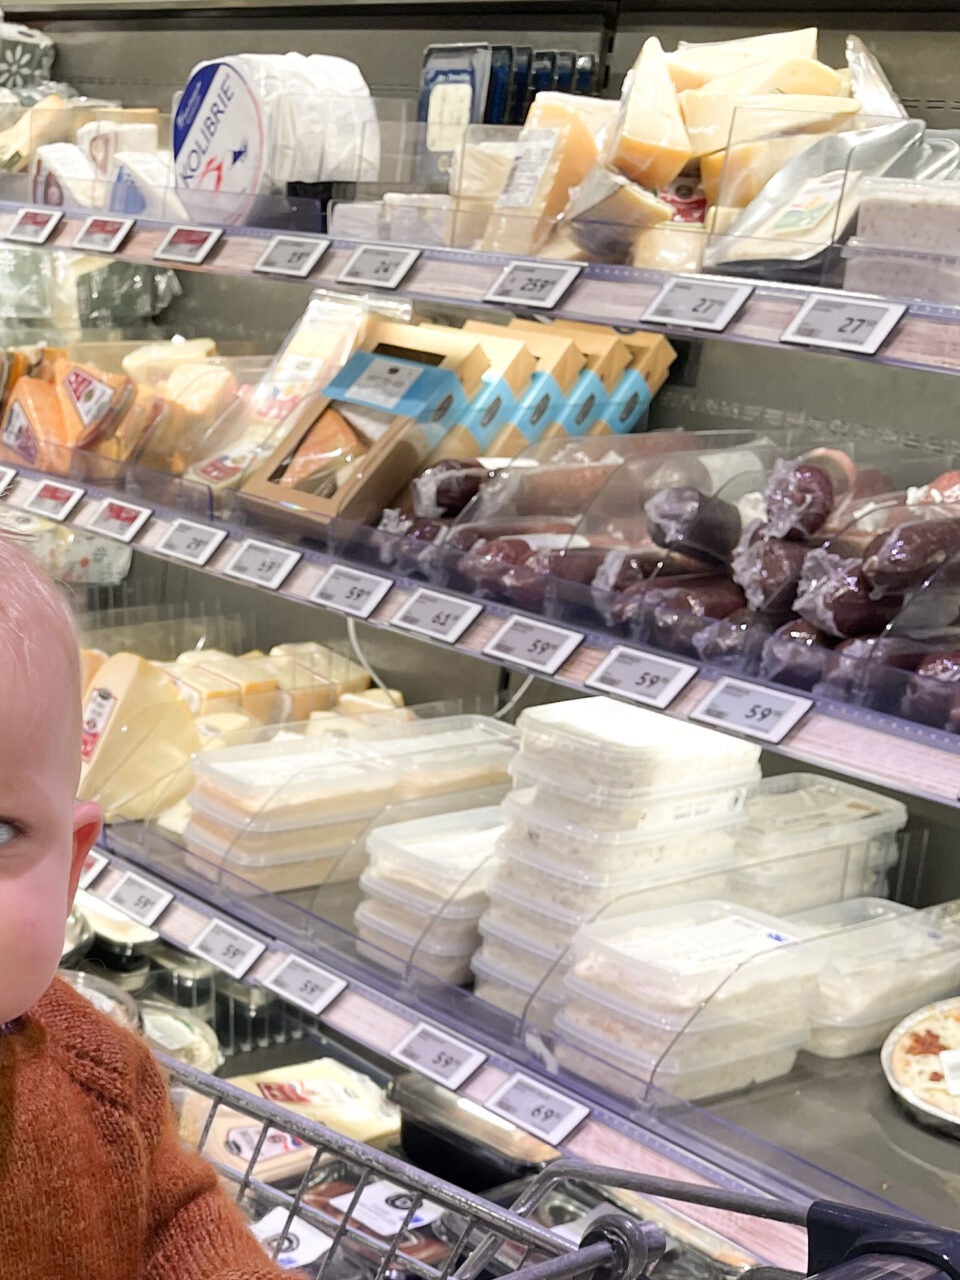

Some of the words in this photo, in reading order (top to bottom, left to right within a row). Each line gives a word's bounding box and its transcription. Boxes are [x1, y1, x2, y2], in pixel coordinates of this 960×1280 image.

[180, 72, 235, 190] KOLIBRIE
[634, 671, 661, 688] 59
[744, 703, 774, 722] 59
[530, 1106, 557, 1126] 69
